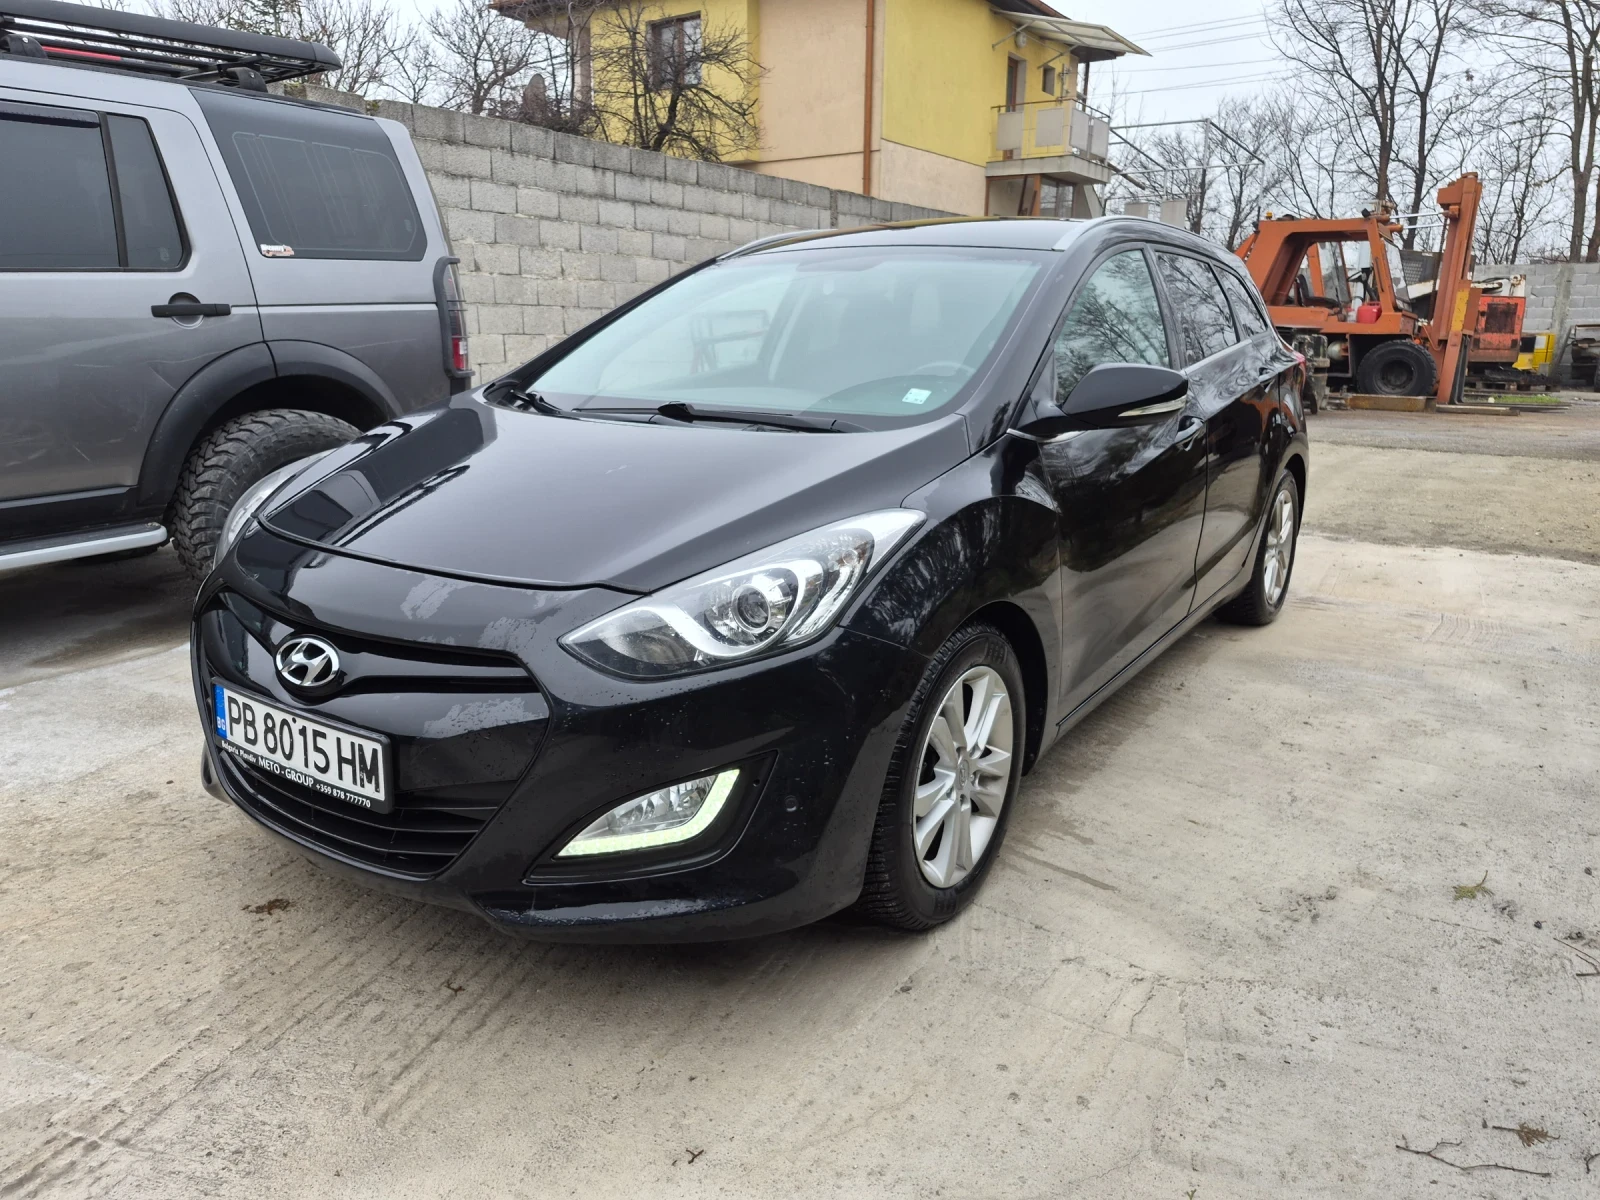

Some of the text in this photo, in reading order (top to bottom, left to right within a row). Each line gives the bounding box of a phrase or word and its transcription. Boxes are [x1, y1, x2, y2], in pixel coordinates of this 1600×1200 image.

[216, 716, 226, 731] BG
[227, 696, 381, 793] PB 8015 HM
[258, 756, 281, 774] METO
[285, 768, 314, 787] GROUP
[316, 783, 332, 794] +359
[332, 788, 345, 799] 878
[345, 793, 371, 808] 777770
